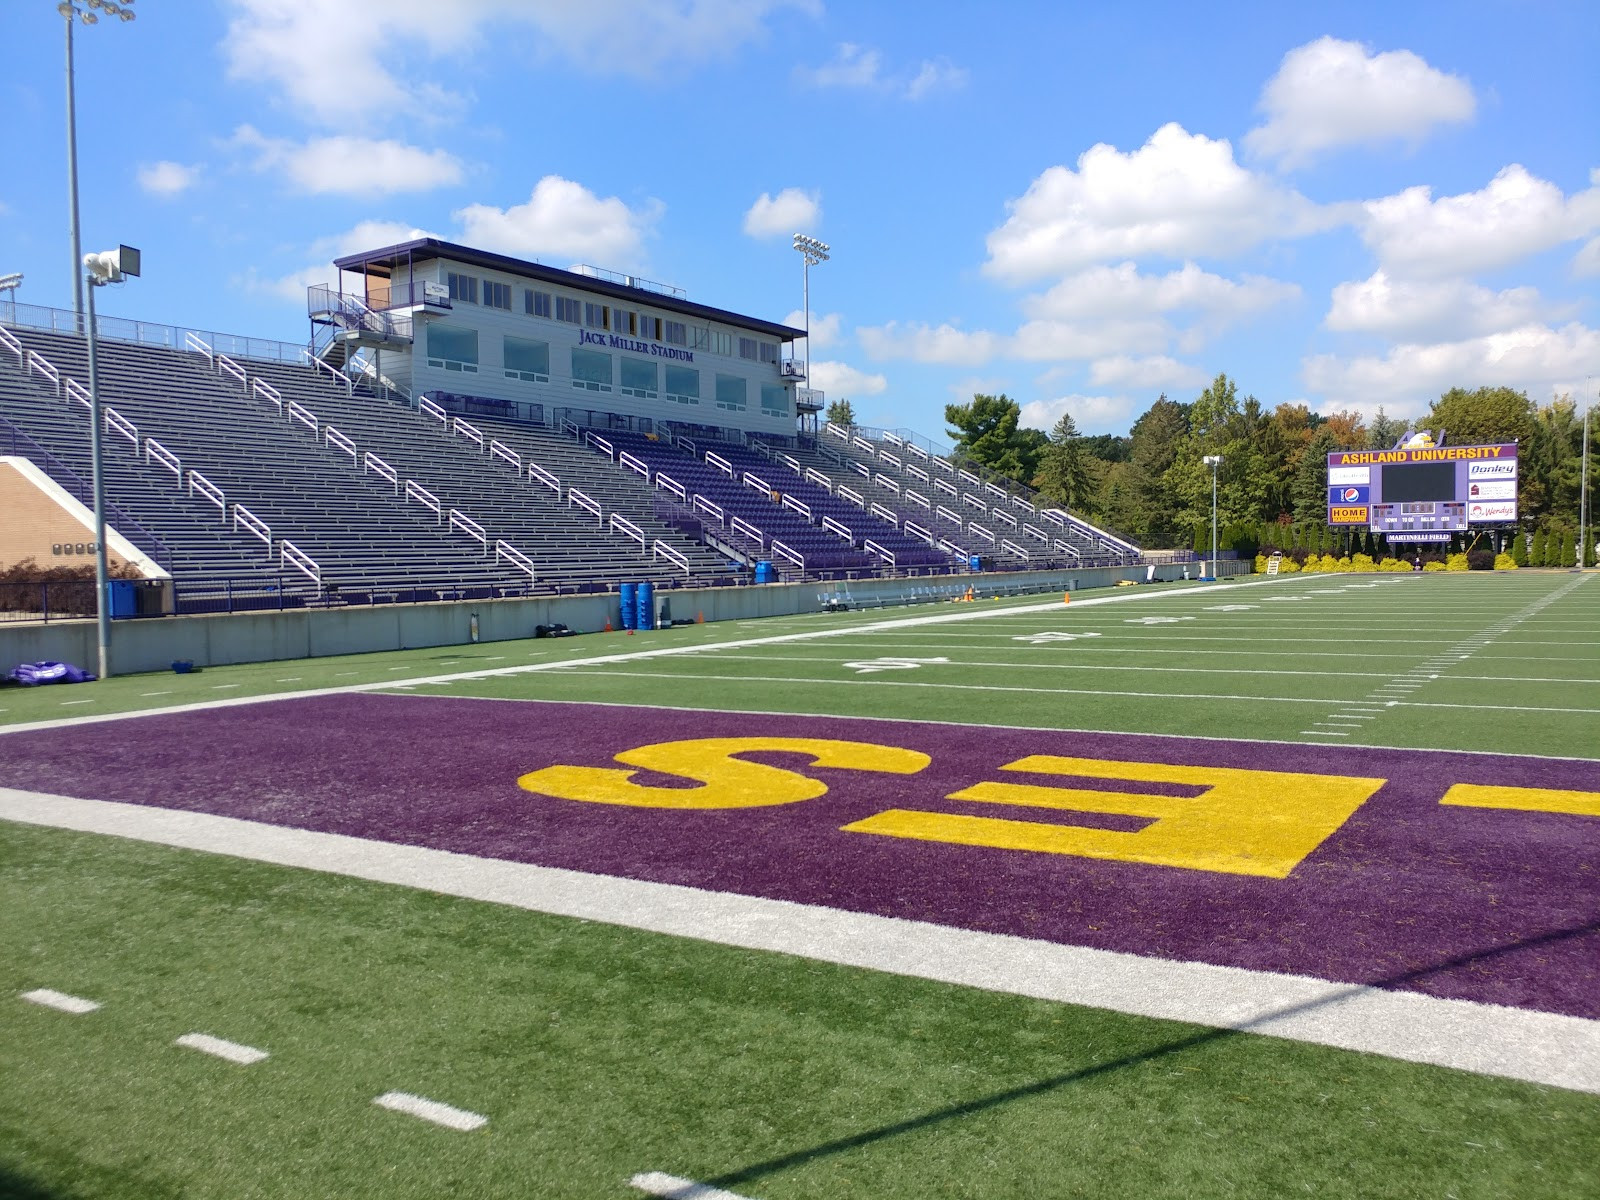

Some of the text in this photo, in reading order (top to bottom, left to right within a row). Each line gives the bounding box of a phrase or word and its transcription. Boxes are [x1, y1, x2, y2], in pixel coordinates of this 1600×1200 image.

[578, 328, 694, 363] JACK MILLER STADIUM
[1341, 447, 1501, 464] ASHLAND UNIVERSITY
[1471, 465, 1514, 474] Donley
[1485, 505, 1514, 516] Wendy's
